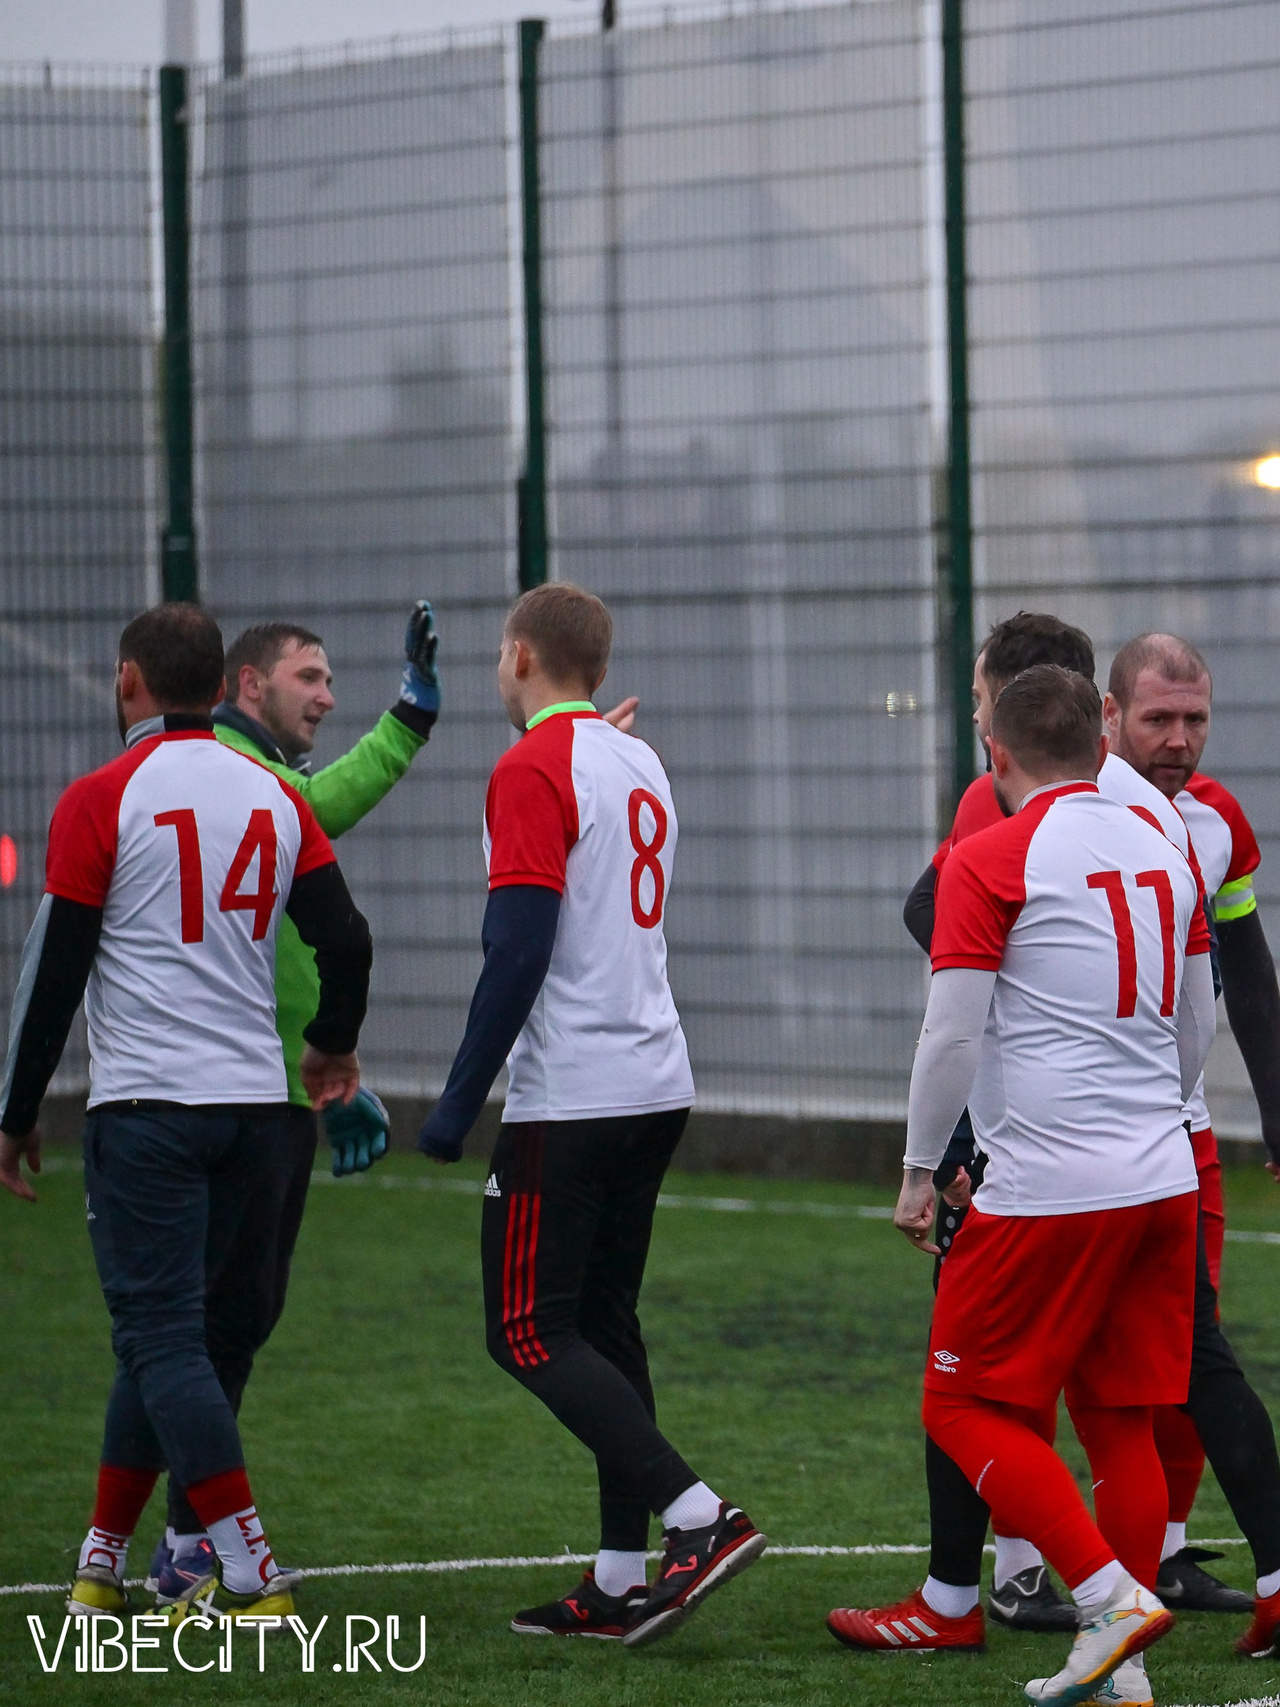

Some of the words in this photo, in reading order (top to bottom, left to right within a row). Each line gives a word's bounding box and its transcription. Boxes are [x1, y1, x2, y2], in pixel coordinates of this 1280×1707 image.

[153, 808, 278, 943] 14
[628, 788, 667, 929] 8
[1086, 870, 1175, 1018] 11
